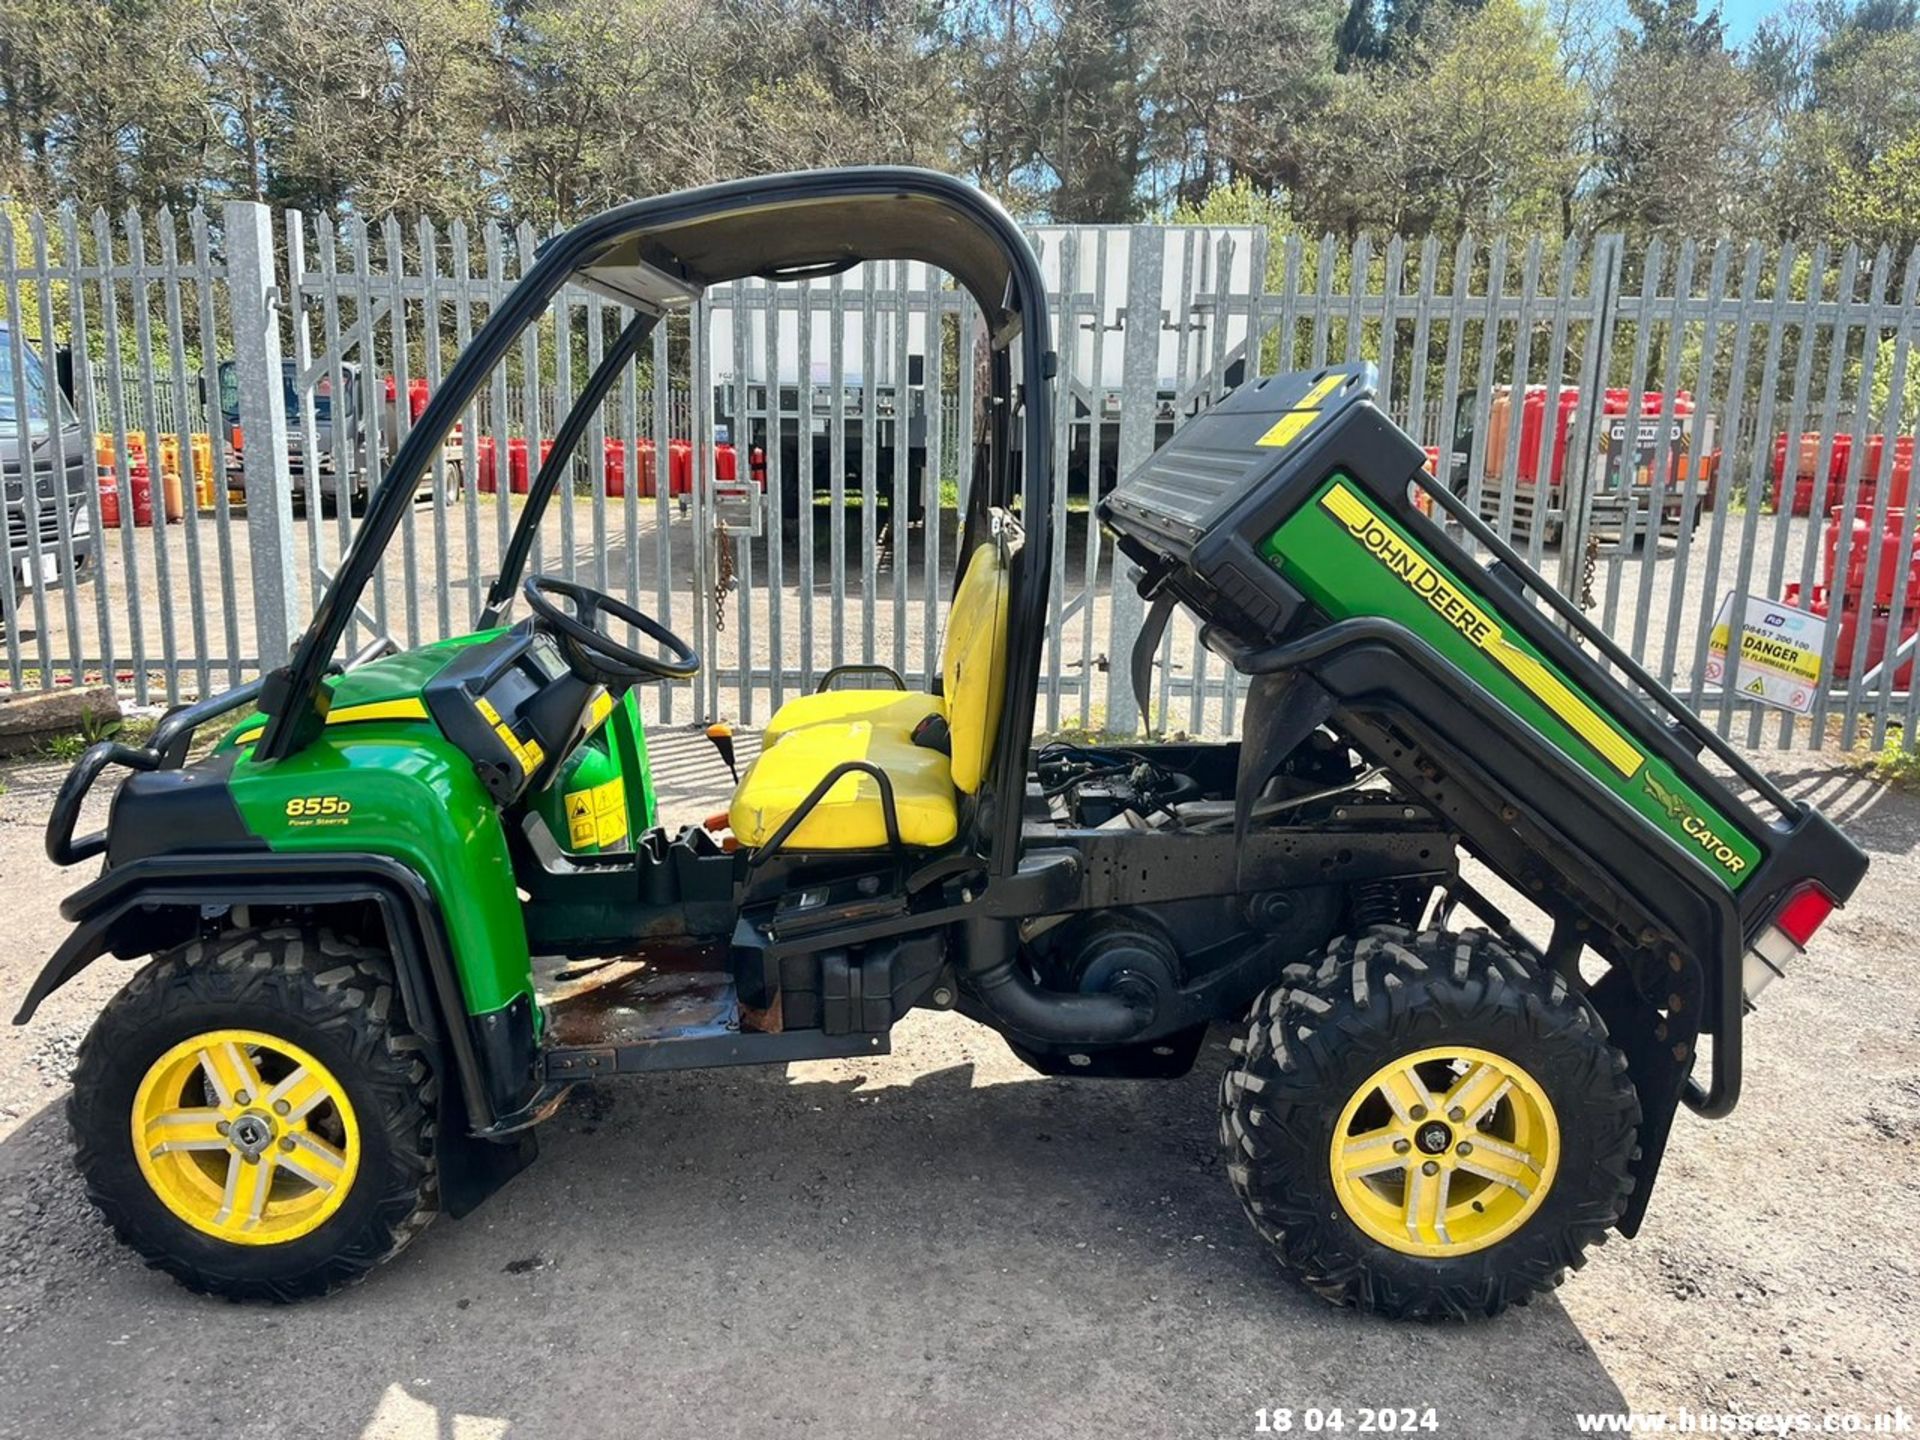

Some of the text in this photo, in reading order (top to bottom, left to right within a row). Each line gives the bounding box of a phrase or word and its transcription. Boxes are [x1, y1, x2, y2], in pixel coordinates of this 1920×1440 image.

[1350, 518, 1491, 643] JOHN DEERE
[1743, 636, 1799, 664] DANGER
[1775, 633, 1792, 645] 200
[1794, 640, 1810, 651] 100
[1750, 652, 1791, 672] FLAMMABLE
[286, 796, 351, 816] 855D
[1682, 816, 1746, 873] GATOR
